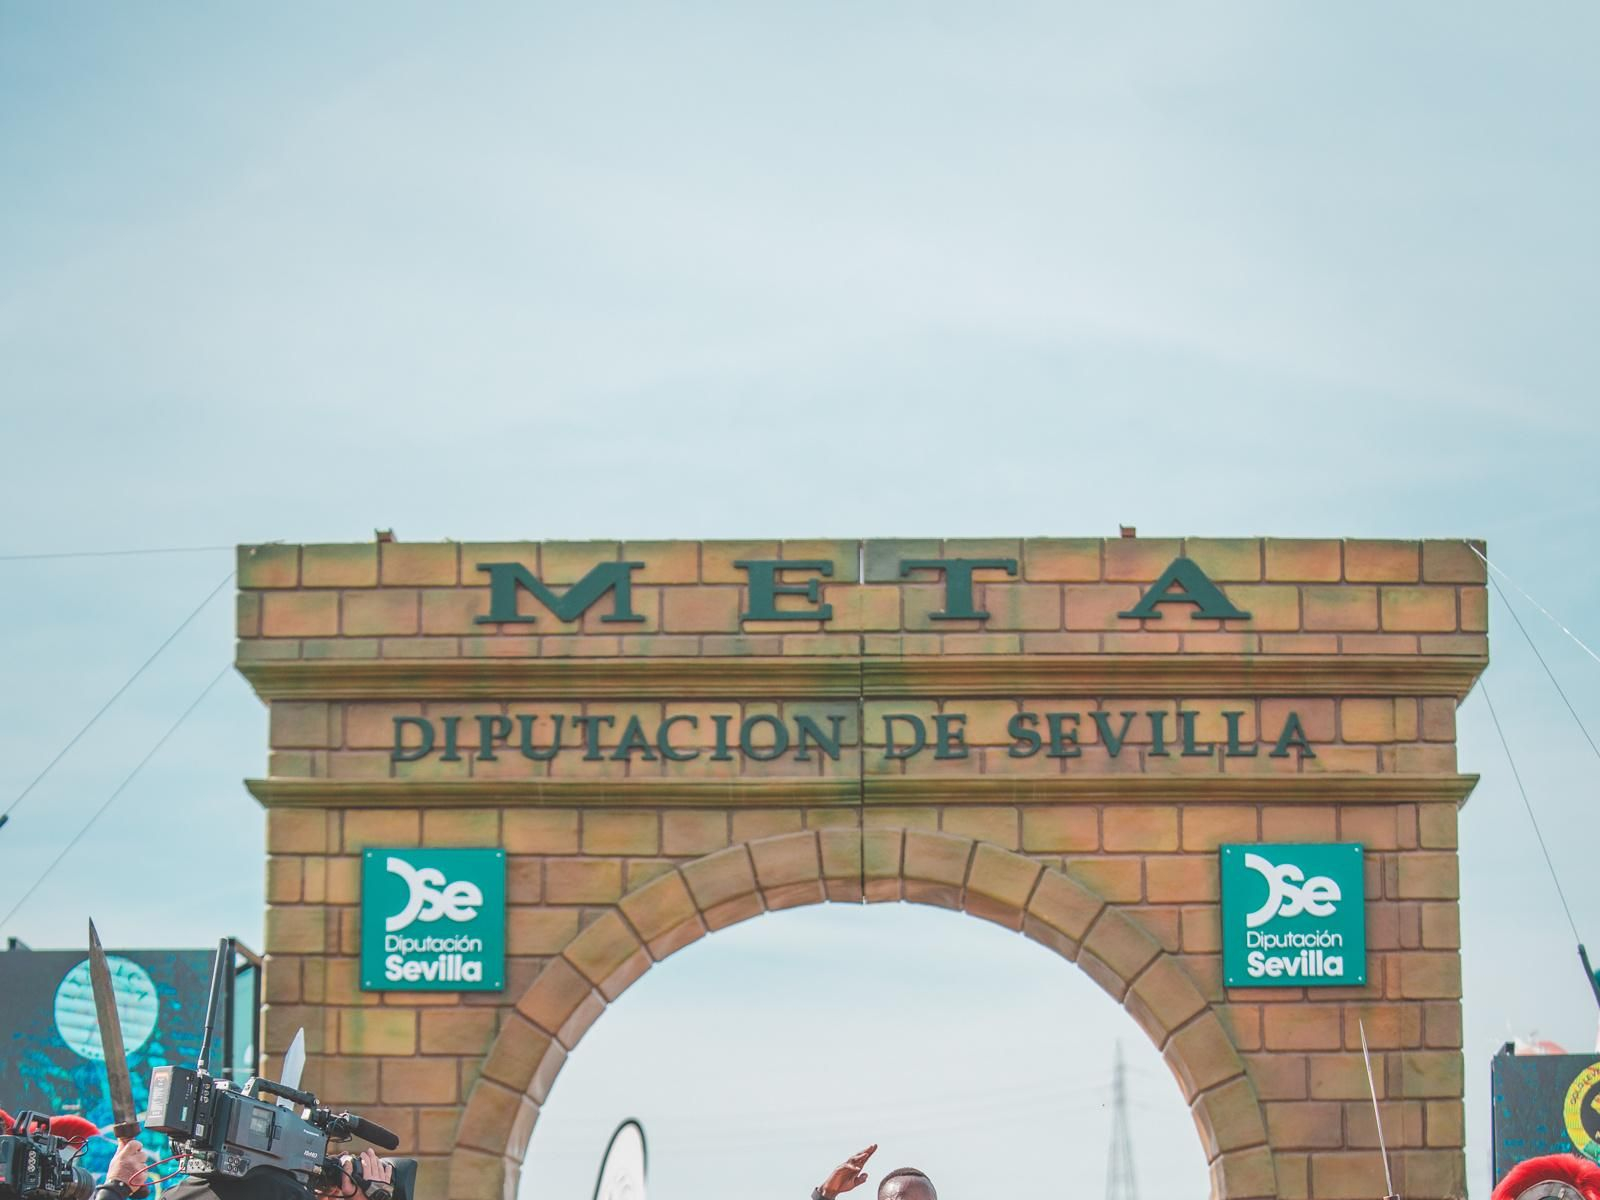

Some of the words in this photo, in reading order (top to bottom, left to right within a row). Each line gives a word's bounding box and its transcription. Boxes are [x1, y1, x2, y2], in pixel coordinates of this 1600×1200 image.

[476, 557, 1252, 625] META
[392, 714, 846, 762] DIPUTACION
[882, 713, 969, 760] DE
[1007, 710, 1316, 759] SEVILLA
[385, 934, 482, 955] Diputación
[1246, 930, 1343, 950] Diputación
[385, 953, 482, 982] Sevilla
[1247, 949, 1344, 977] Sevilla
